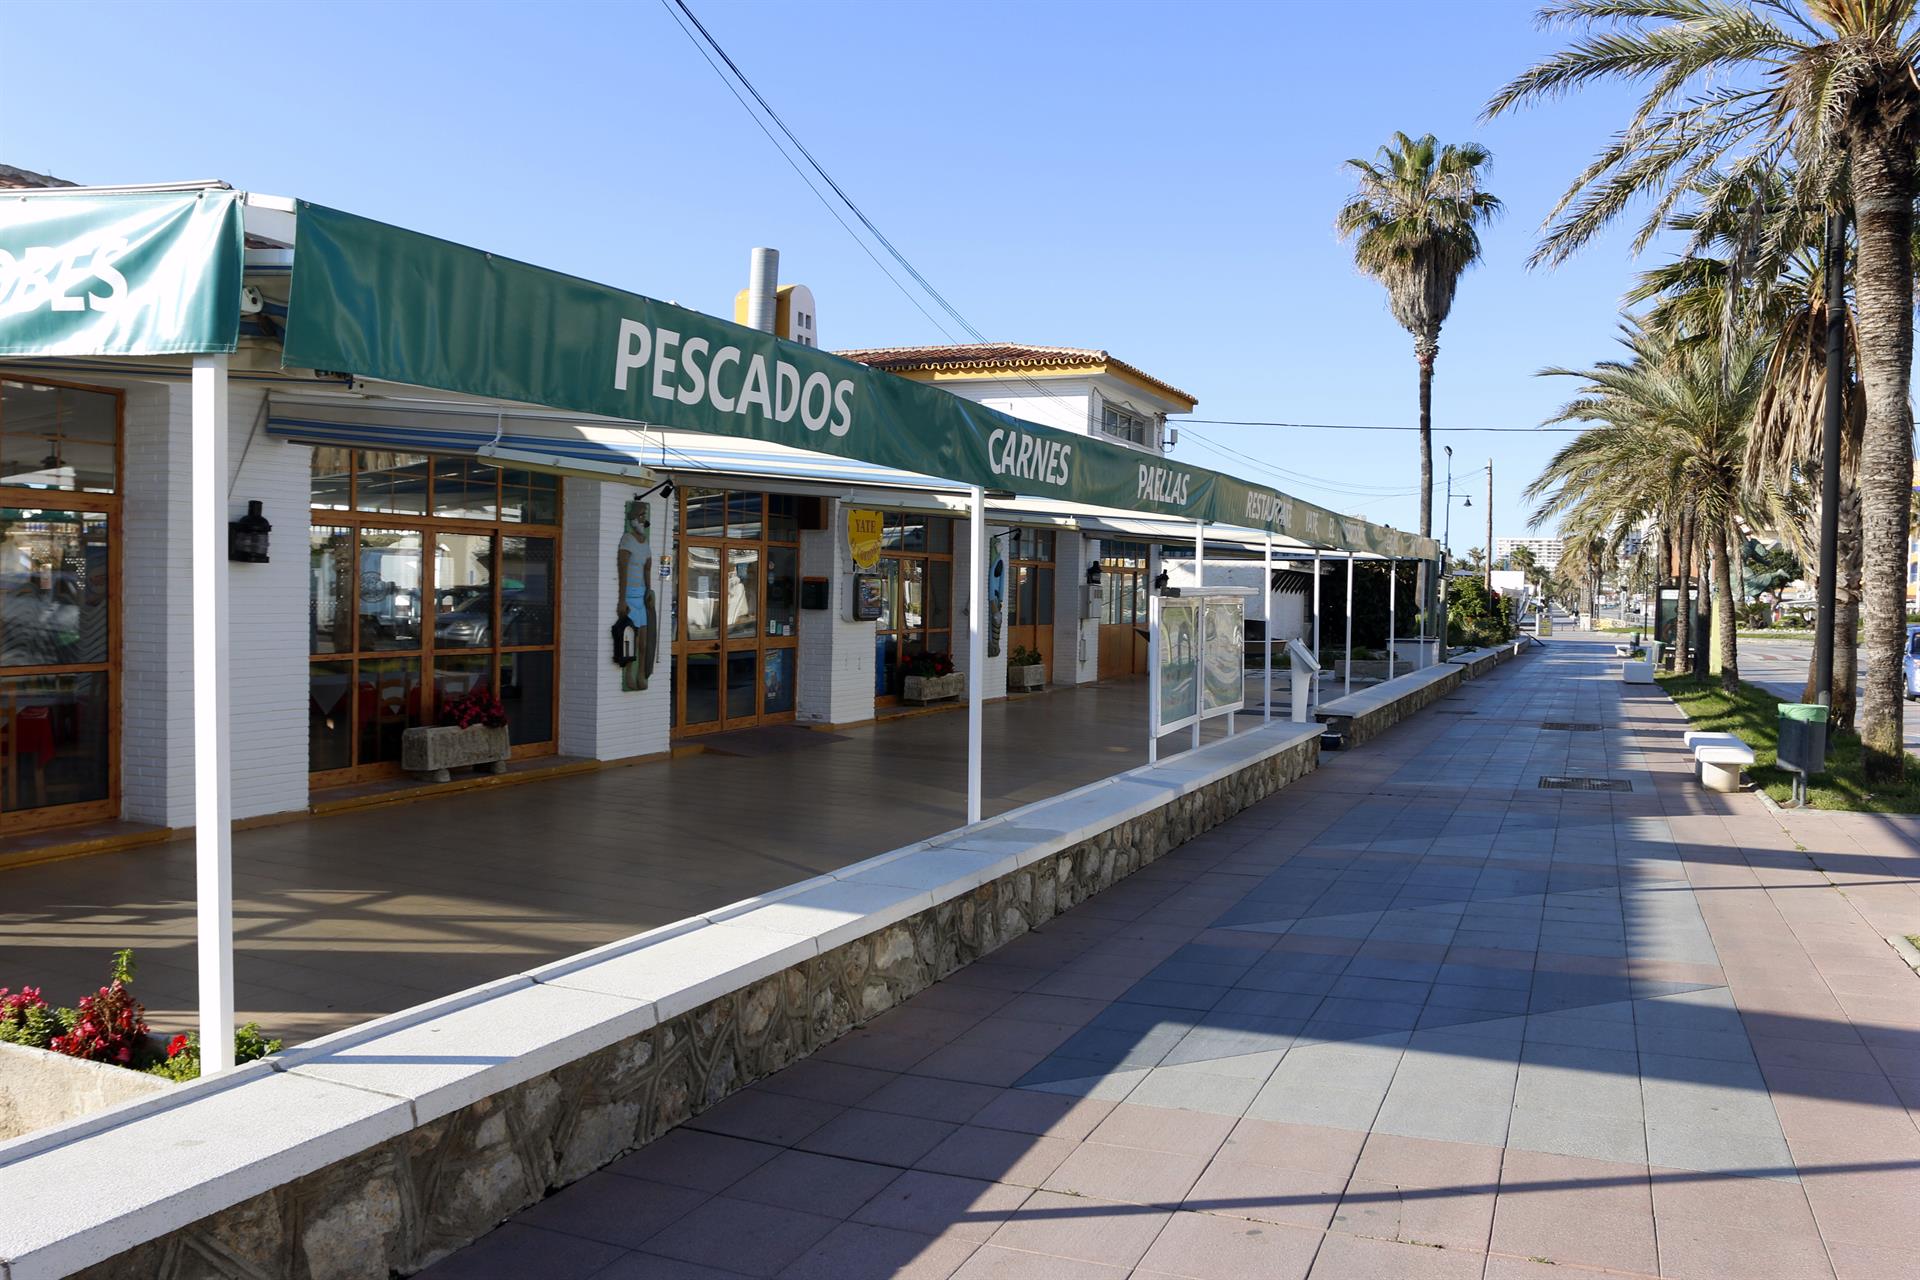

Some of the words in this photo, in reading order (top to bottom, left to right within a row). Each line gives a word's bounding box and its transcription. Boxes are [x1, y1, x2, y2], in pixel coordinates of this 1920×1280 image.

[614, 318, 854, 437] PESCADOS
[988, 428, 1072, 486] CARNES
[1137, 464, 1191, 506] PAELLAS
[855, 519, 877, 533] YATE
